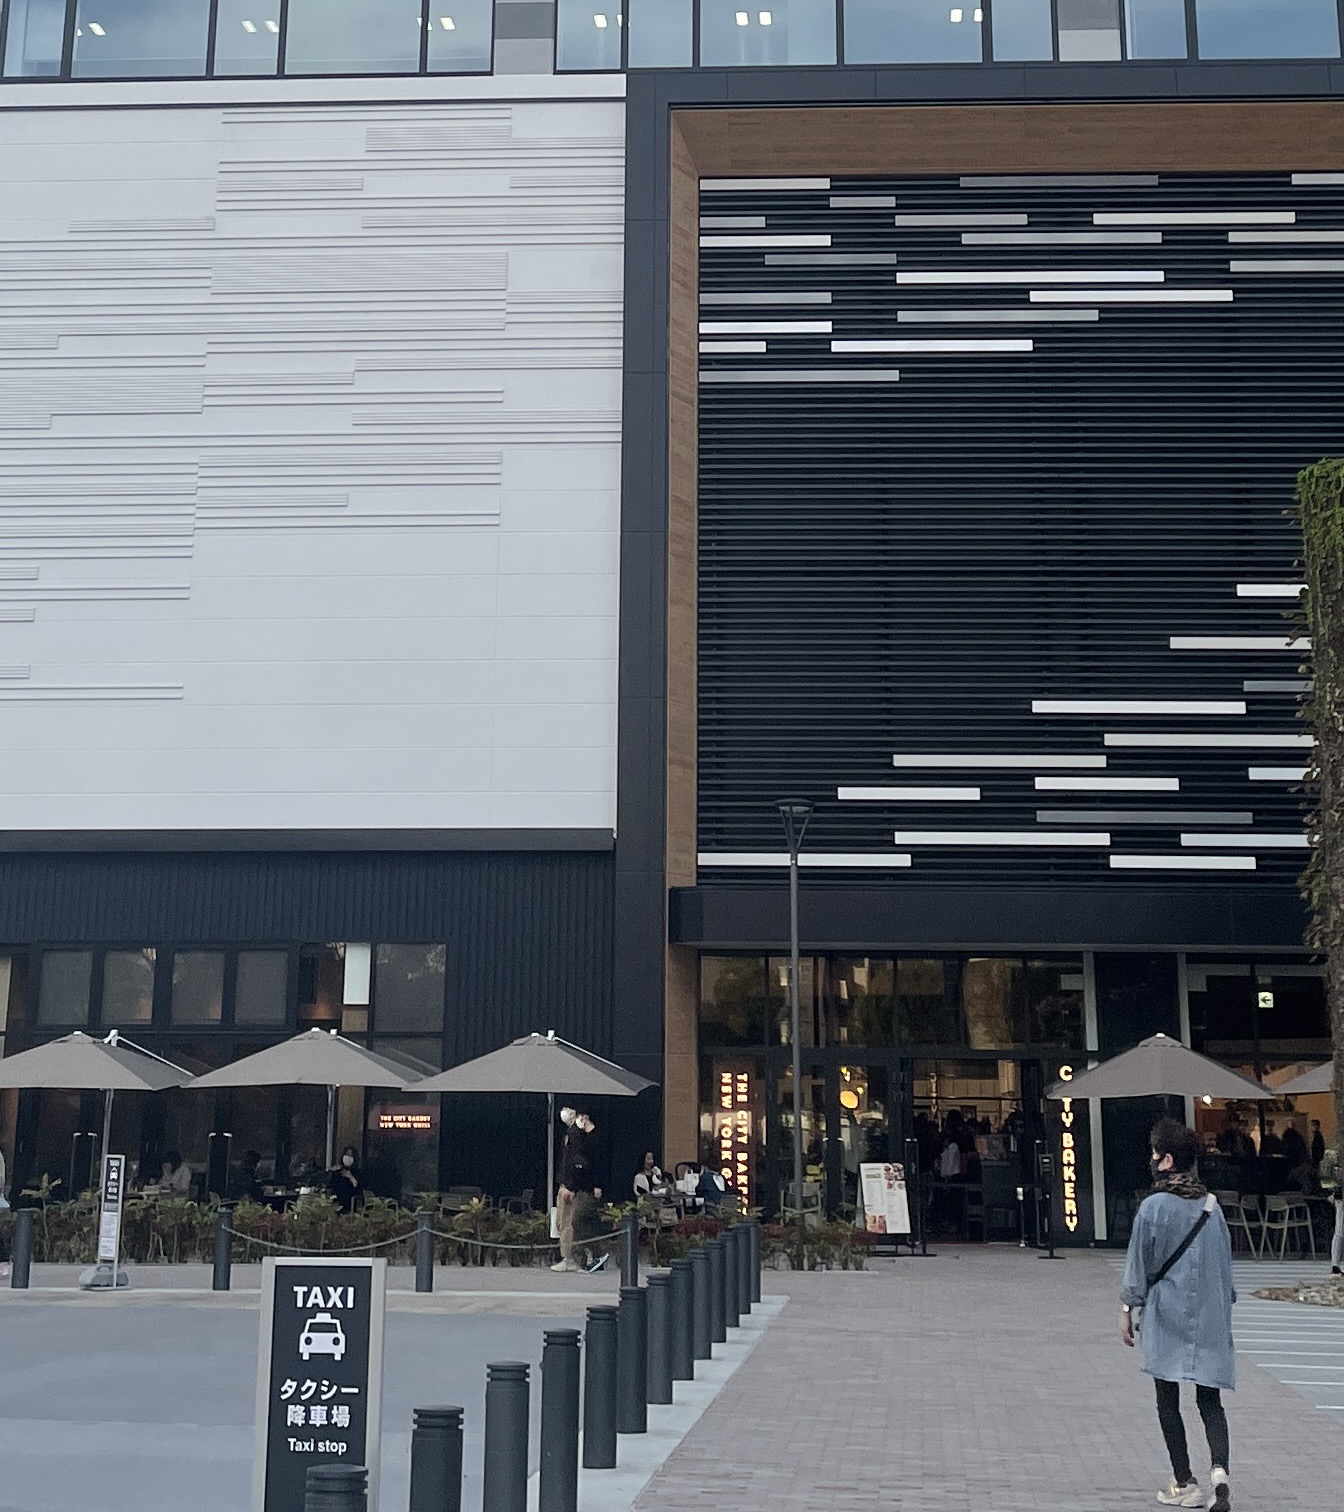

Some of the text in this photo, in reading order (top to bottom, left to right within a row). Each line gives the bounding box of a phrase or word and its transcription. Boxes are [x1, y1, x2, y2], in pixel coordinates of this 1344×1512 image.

[720, 1072, 733, 1109] NEW
[736, 1072, 749, 1103] THE
[720, 1116, 733, 1161] YORK
[736, 1109, 749, 1145] CITY
[1059, 1065, 1079, 1232] CTY BAKERY
[293, 1285, 355, 1309] TAXI
[280, 1378, 359, 1401] タクシー
[286, 1404, 351, 1428] 降車場
[287, 1438, 347, 1456] Taxi stop
